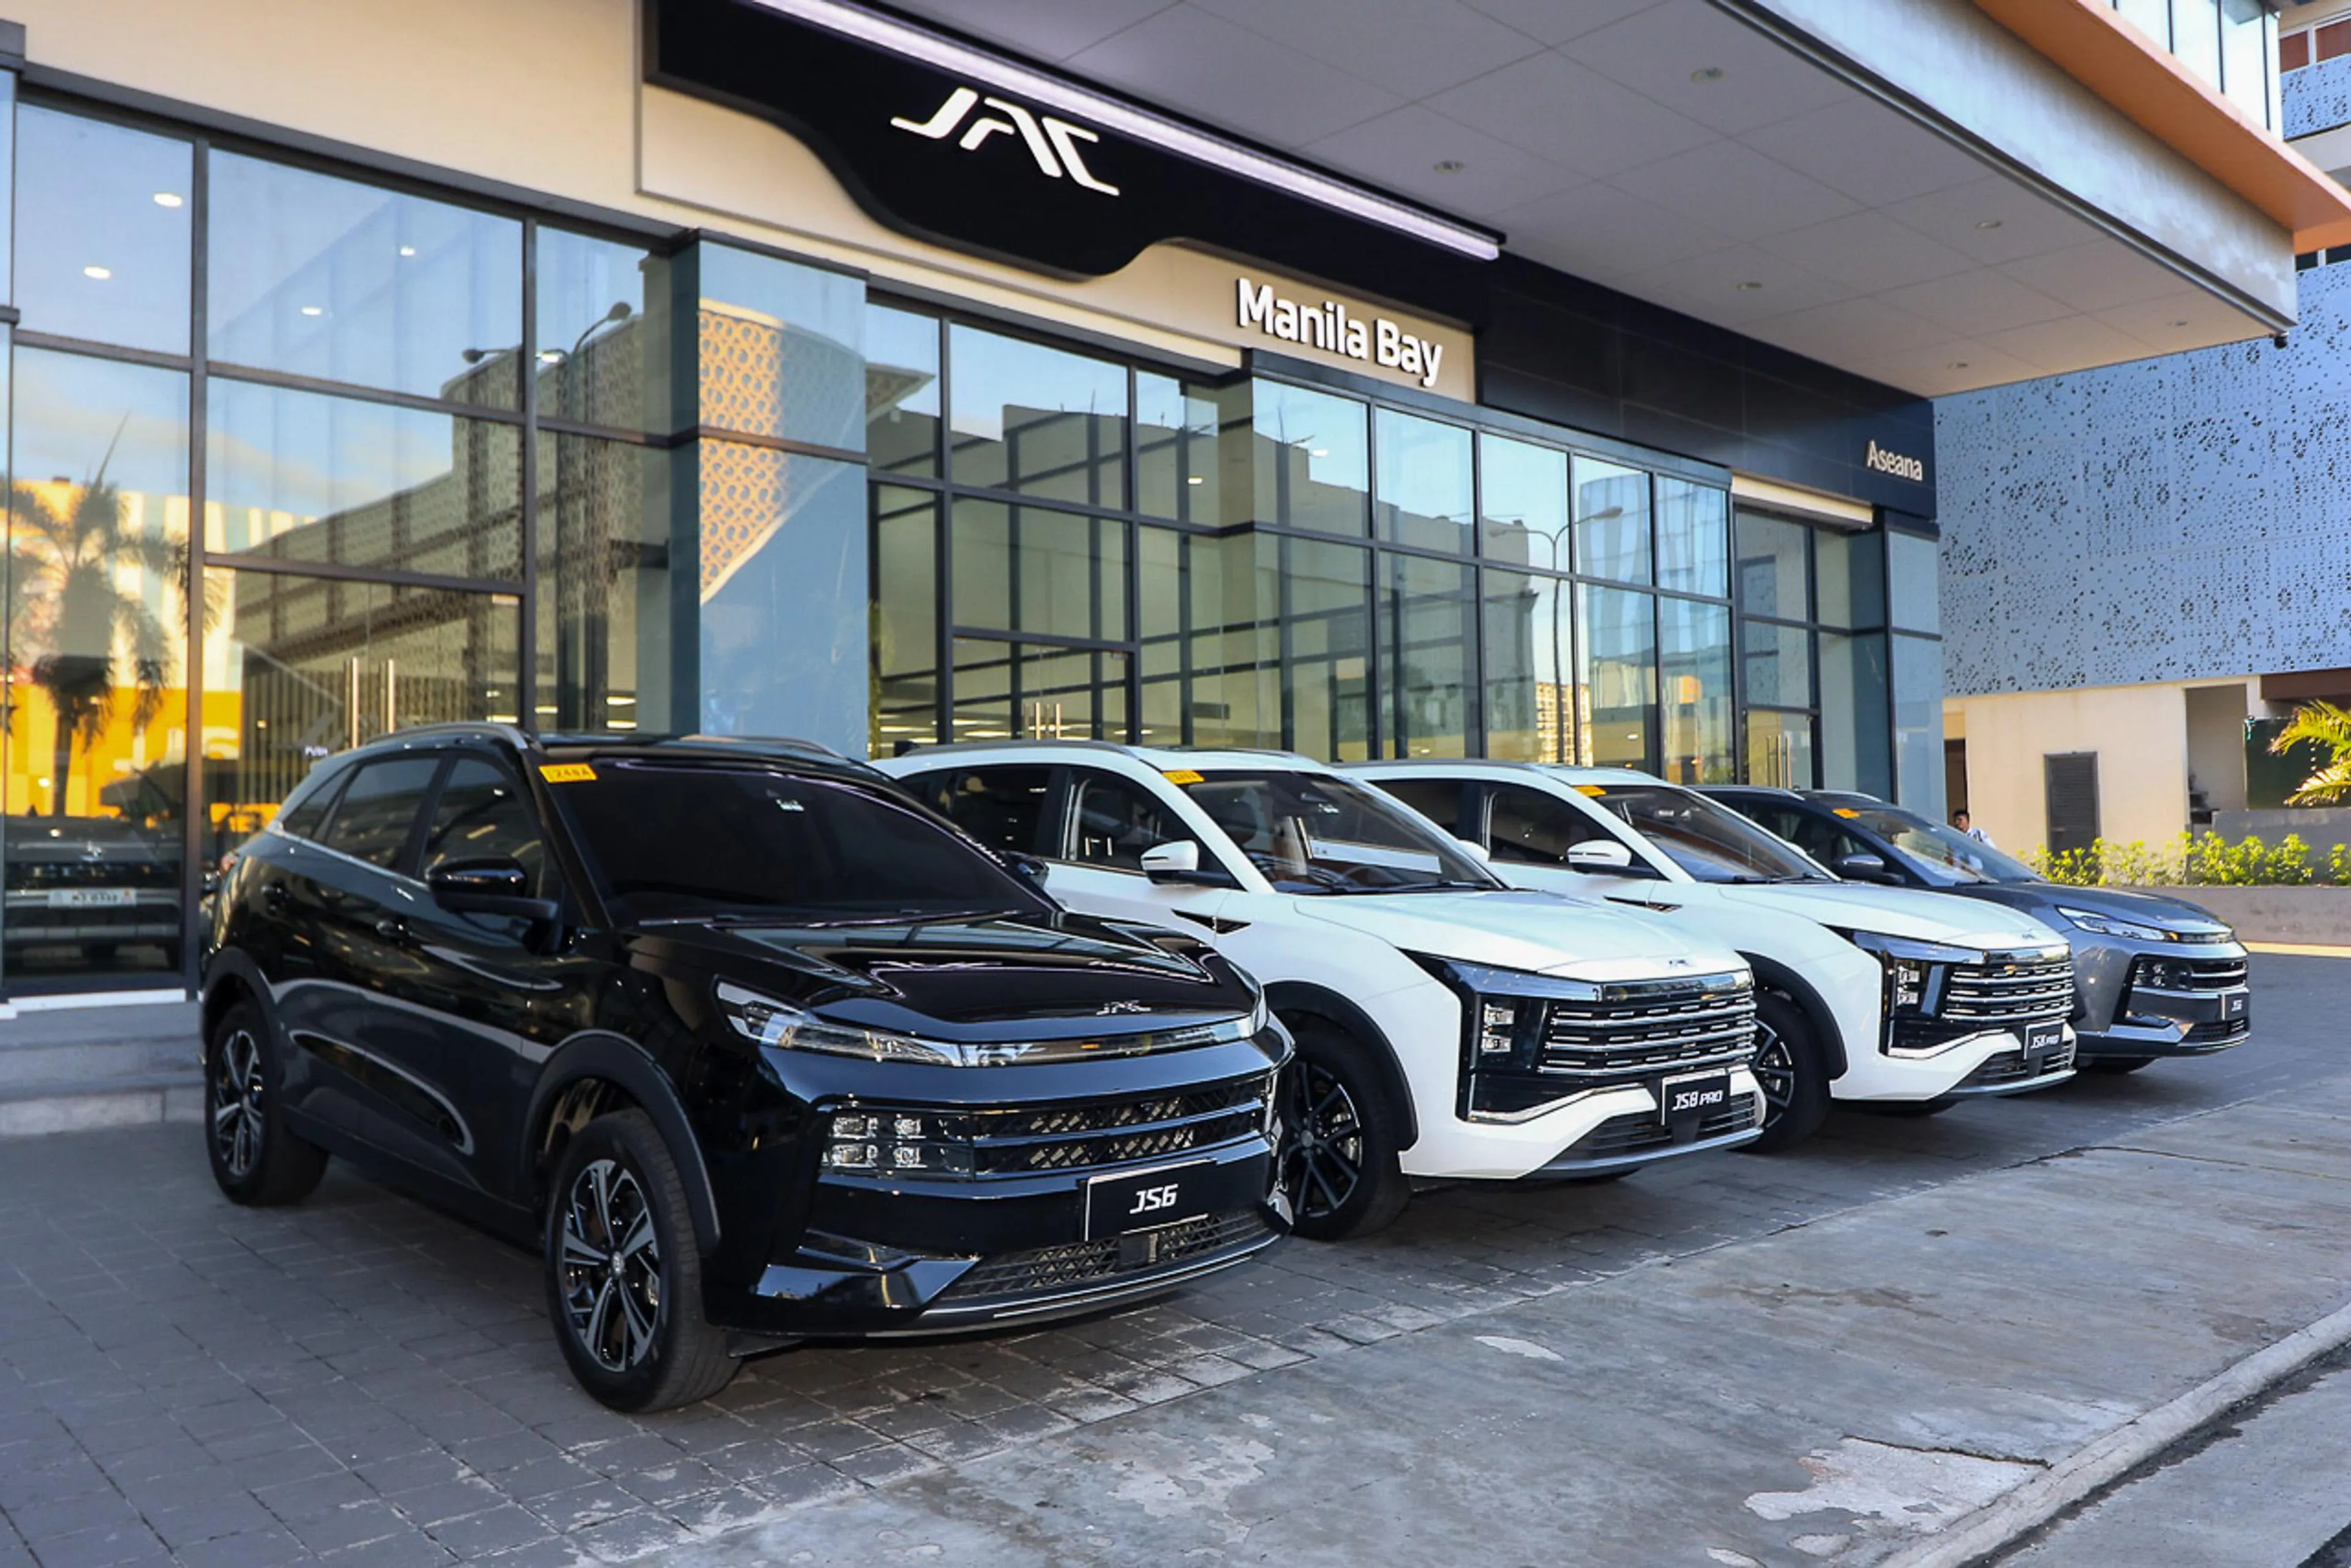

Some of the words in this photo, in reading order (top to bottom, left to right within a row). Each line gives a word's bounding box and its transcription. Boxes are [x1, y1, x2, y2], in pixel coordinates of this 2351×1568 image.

[891, 88, 1120, 196] JAC
[1238, 277, 1369, 360] Manila
[1376, 318, 1443, 388] Bay
[1867, 440, 1923, 481] Aseana
[1671, 1090, 1698, 1111] JS8
[1699, 1090, 1723, 1106] PRO
[1129, 1183, 1179, 1214] JS6
